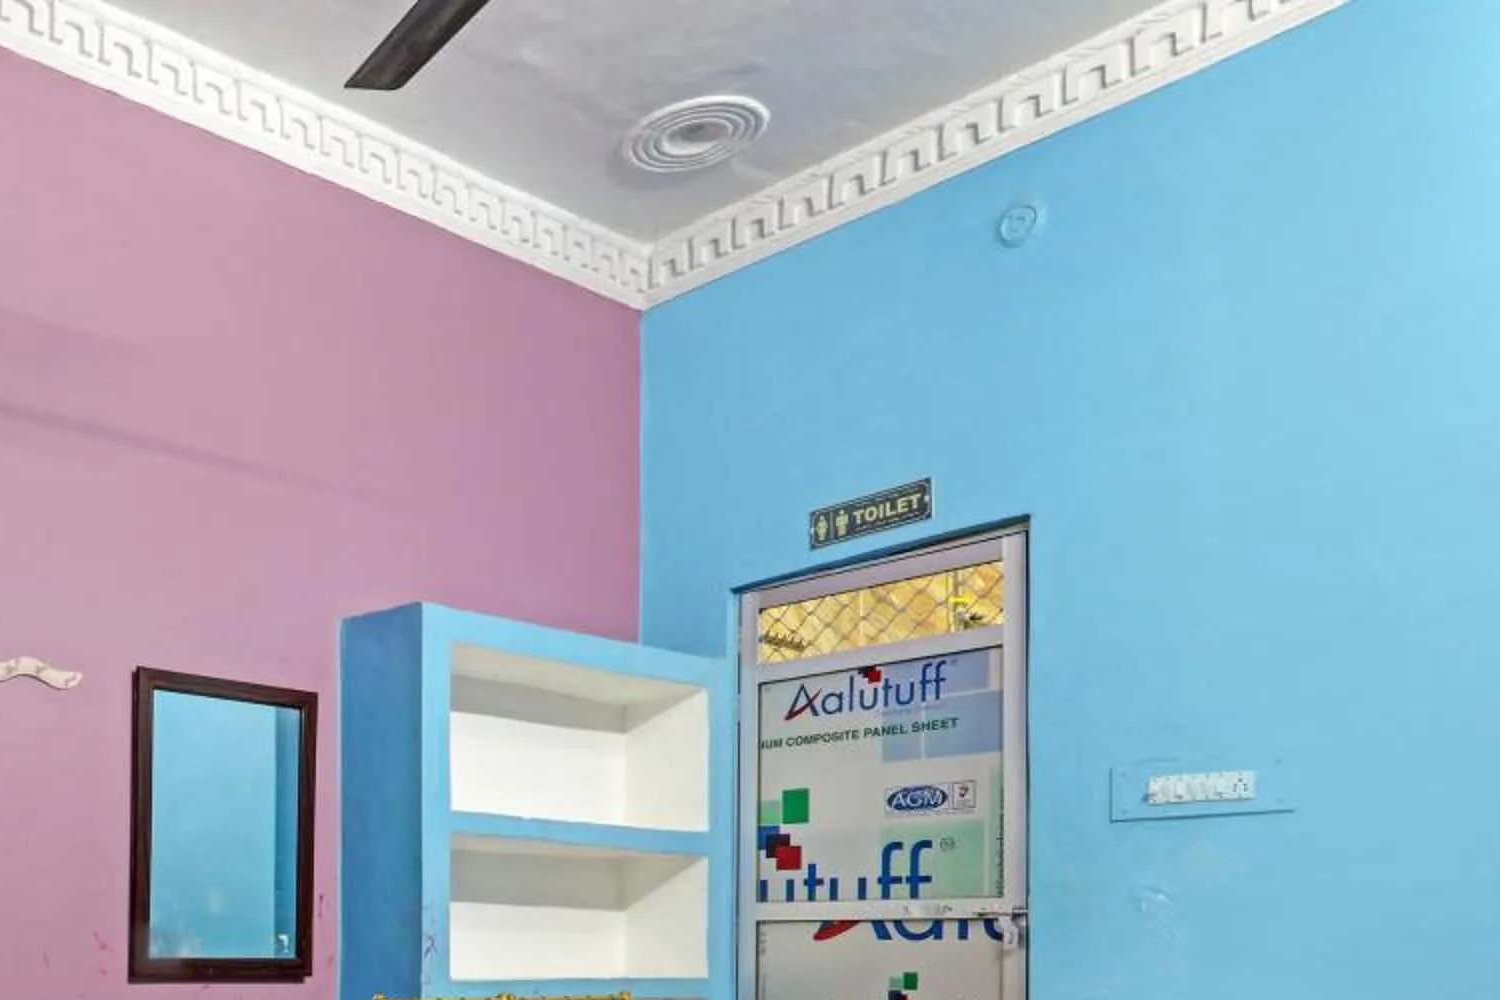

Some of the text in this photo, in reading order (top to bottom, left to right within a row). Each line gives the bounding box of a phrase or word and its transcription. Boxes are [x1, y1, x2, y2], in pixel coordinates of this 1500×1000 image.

[853, 492, 922, 524] TOILET
[784, 659, 947, 721] Aalutuff
[786, 729, 860, 748] COMPOSITE
[863, 722, 908, 739] PANEL
[911, 717, 959, 733] SHEET
